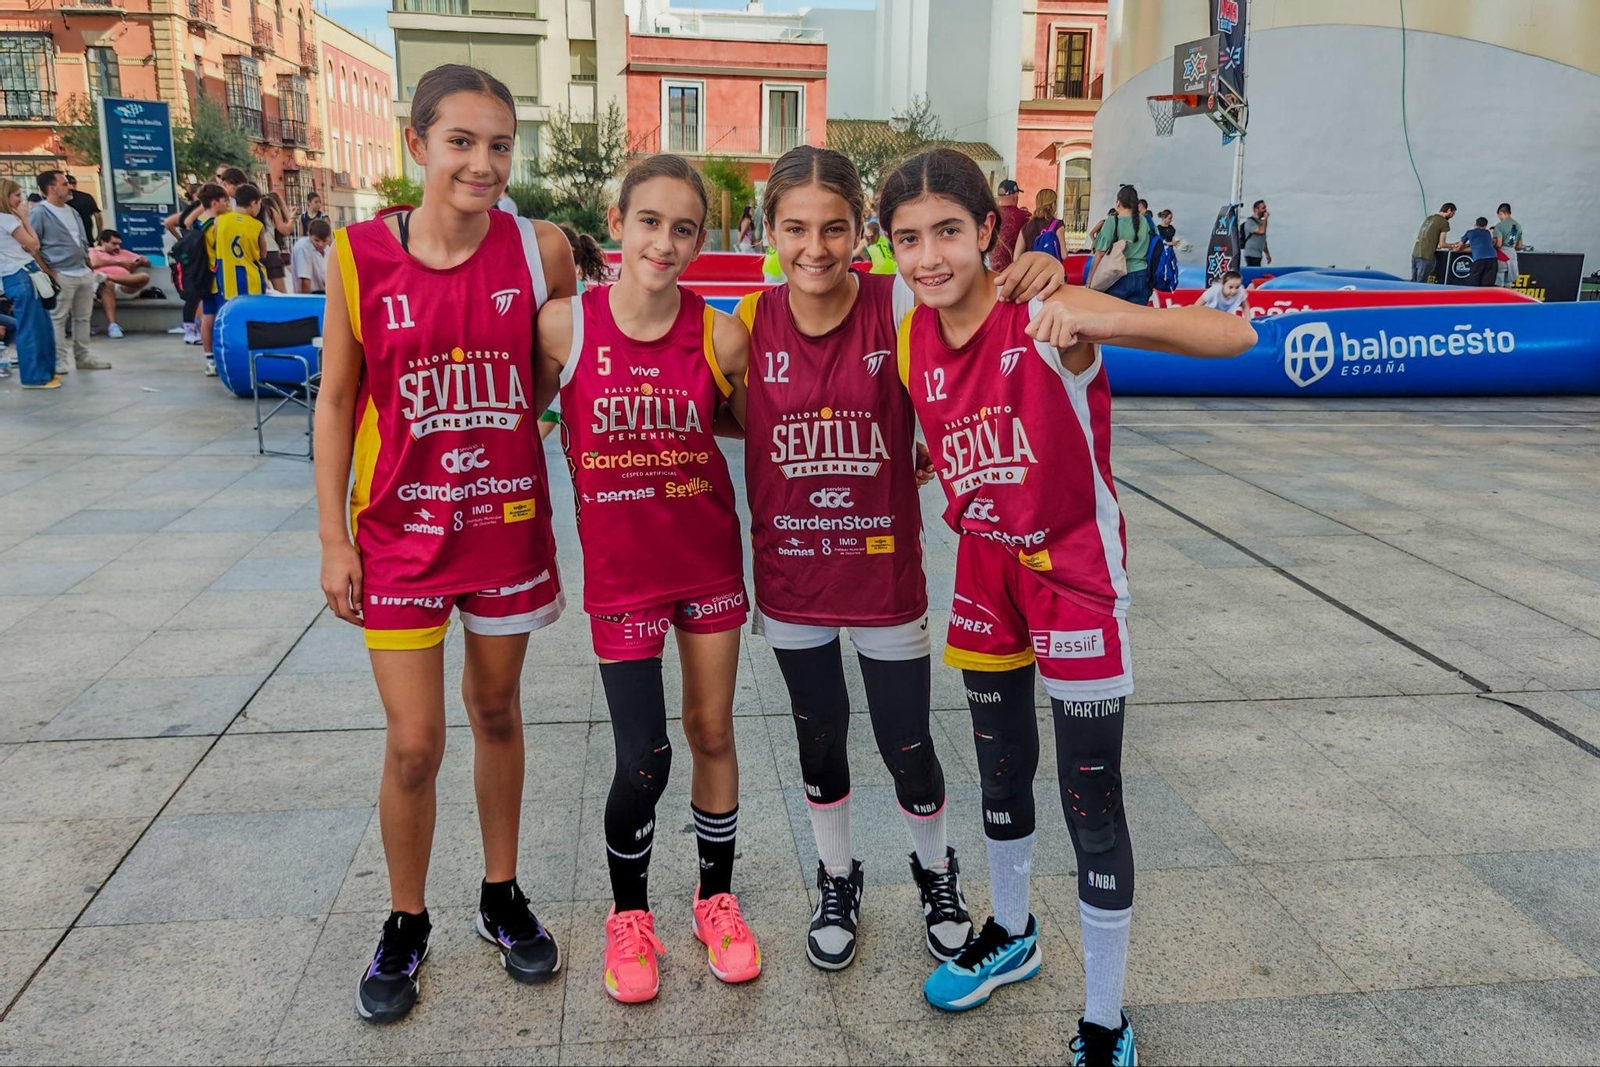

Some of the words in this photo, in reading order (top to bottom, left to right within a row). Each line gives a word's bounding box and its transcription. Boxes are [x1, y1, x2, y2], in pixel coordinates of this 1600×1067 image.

[231, 236, 244, 258] 6
[382, 294, 415, 330] 11
[597, 346, 612, 376] 5
[763, 351, 790, 383] 12
[1340, 361, 1405, 376] ESPAÑA
[629, 366, 660, 377] vive
[399, 362, 529, 420] SEVILLA
[924, 367, 947, 403] 12
[591, 395, 704, 434] SEVILLA
[421, 416, 508, 433] FEMENINO
[609, 432, 686, 443] FEMENINO
[770, 420, 891, 463] SEVILLA
[581, 450, 709, 469] GardenStore
[792, 464, 870, 475] FEMENINO
[397, 477, 533, 502] GardenStore
[665, 477, 709, 495] Sevilla
[597, 487, 656, 503] DAMAS
[472, 504, 493, 515] IMD
[403, 524, 445, 535] DAMAS
[773, 514, 892, 530] GardenStore
[839, 538, 858, 546] IMD
[778, 547, 815, 556] DAMAS
[1063, 698, 1120, 718] MARTINA
[920, 802, 937, 813] NBA
[993, 811, 1011, 824] NBA
[1095, 873, 1116, 890] NBA
